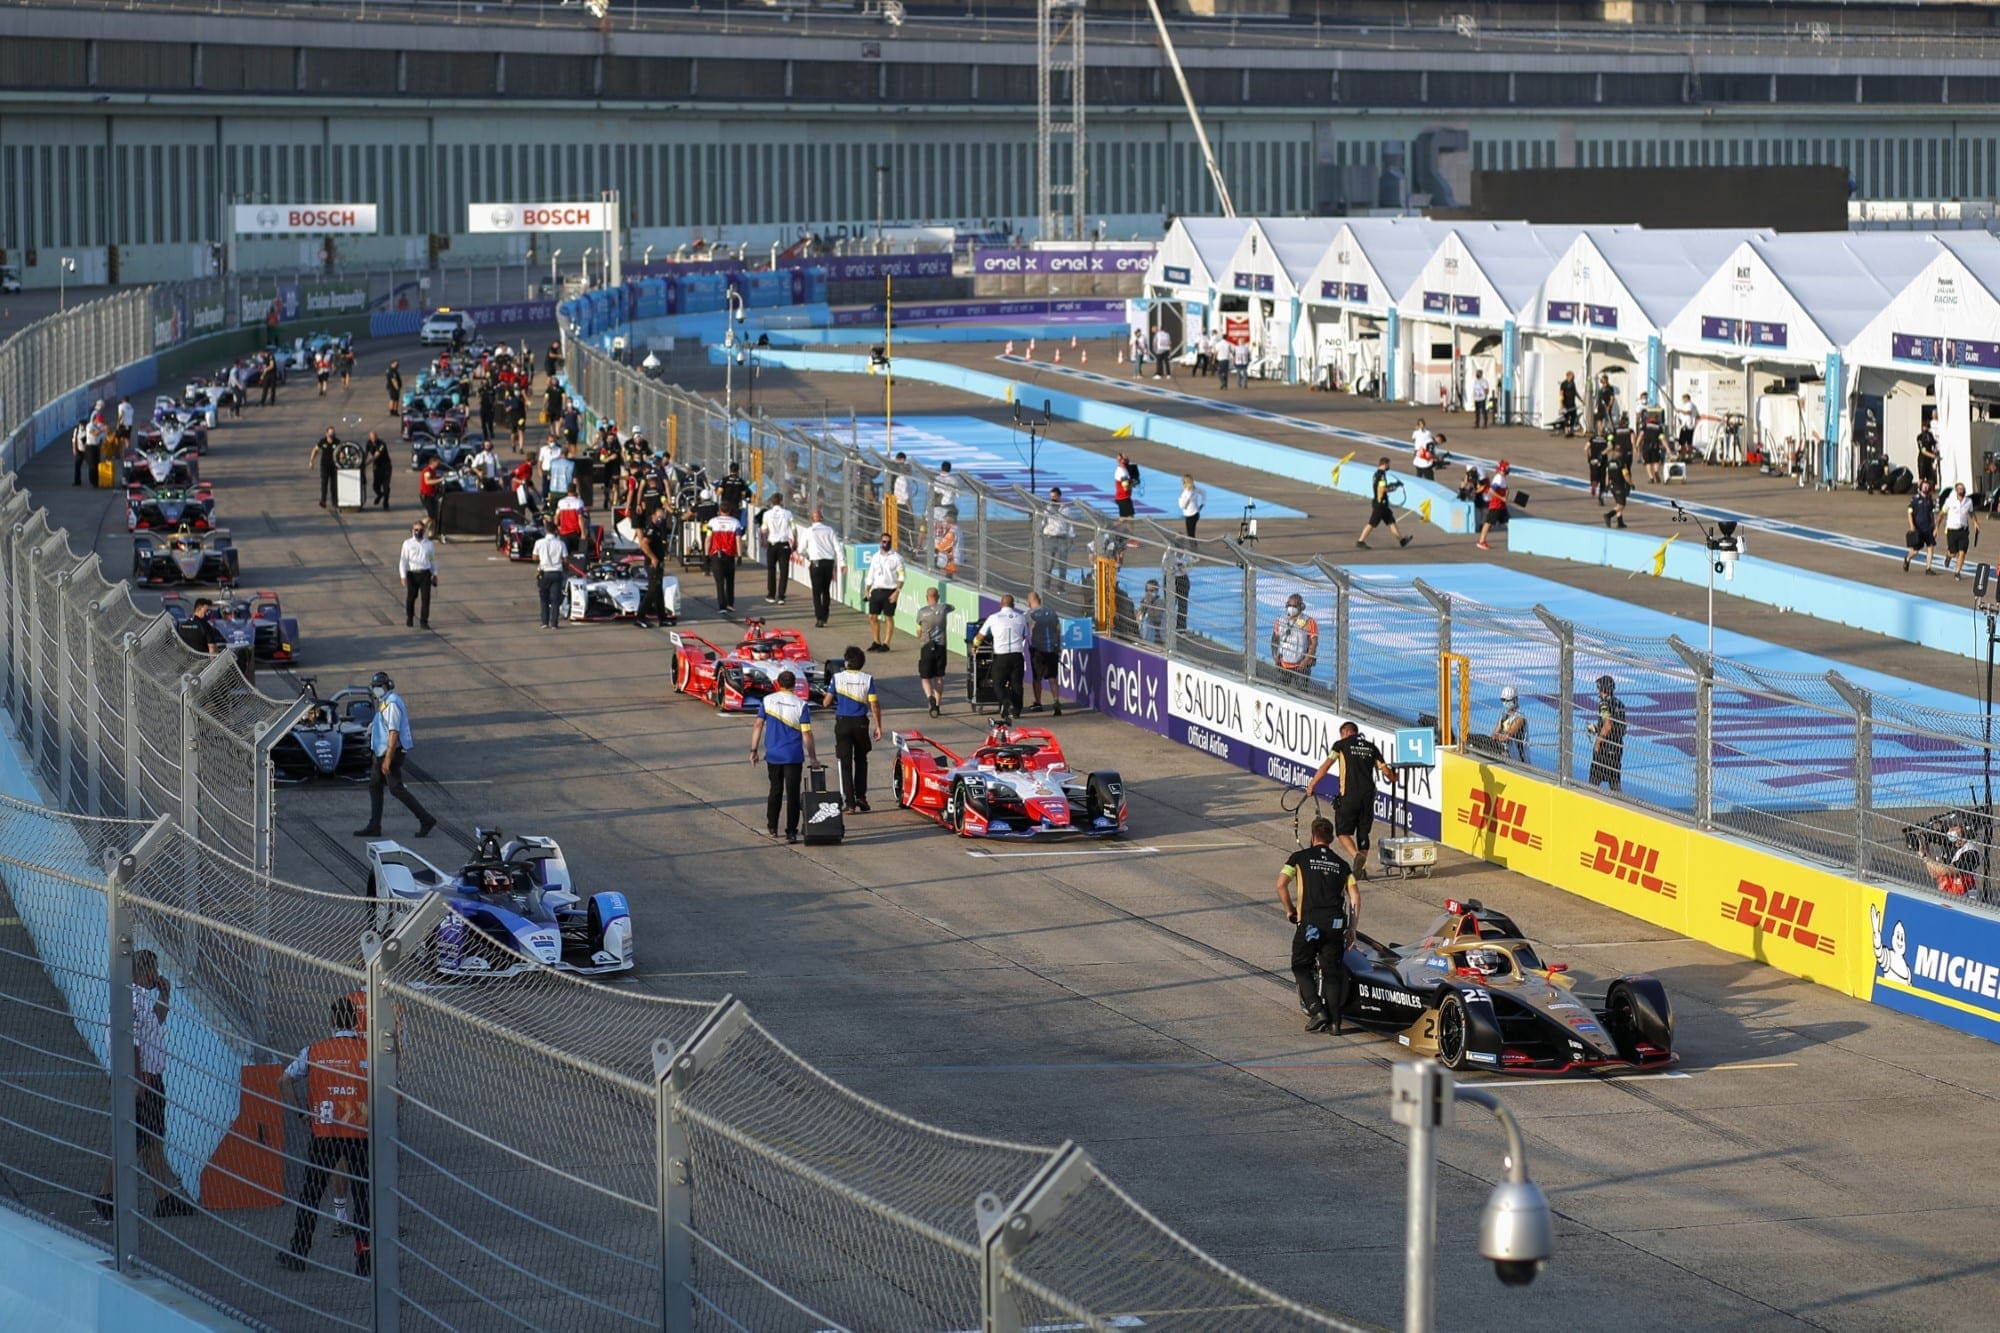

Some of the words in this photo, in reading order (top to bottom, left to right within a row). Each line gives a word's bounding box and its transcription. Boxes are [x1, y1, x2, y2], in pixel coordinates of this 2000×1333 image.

[289, 211, 355, 226] BOSCH
[523, 209, 590, 225] BOSCH
[984, 256, 1021, 270] enel
[1025, 258, 1038, 270] x
[1051, 256, 1088, 270] enel
[1091, 258, 1104, 270] x
[863, 550, 872, 564] 6
[1072, 626, 1083, 641] 5
[1078, 651, 1089, 696] x
[1106, 659, 1143, 717] enel
[1146, 674, 1158, 723] x
[1185, 674, 1243, 733] SAUDIA
[1187, 725, 1209, 751] Official
[1208, 735, 1229, 759] Airline
[1265, 702, 1330, 761] SAUDIA
[1408, 738, 1423, 761] 4
[1268, 756, 1292, 783] Official
[1292, 767, 1314, 789] Airlin
[1468, 787, 1531, 846] DHL
[1592, 830, 1664, 893] DHL
[1736, 879, 1820, 949] DHL
[1914, 945, 2000, 1001] MICHE
[1359, 984, 1370, 997] DS
[1371, 986, 1422, 1009] AUTOMOBILES
[1461, 988, 1490, 1003] 25
[327, 1086, 358, 1096] TRACK
